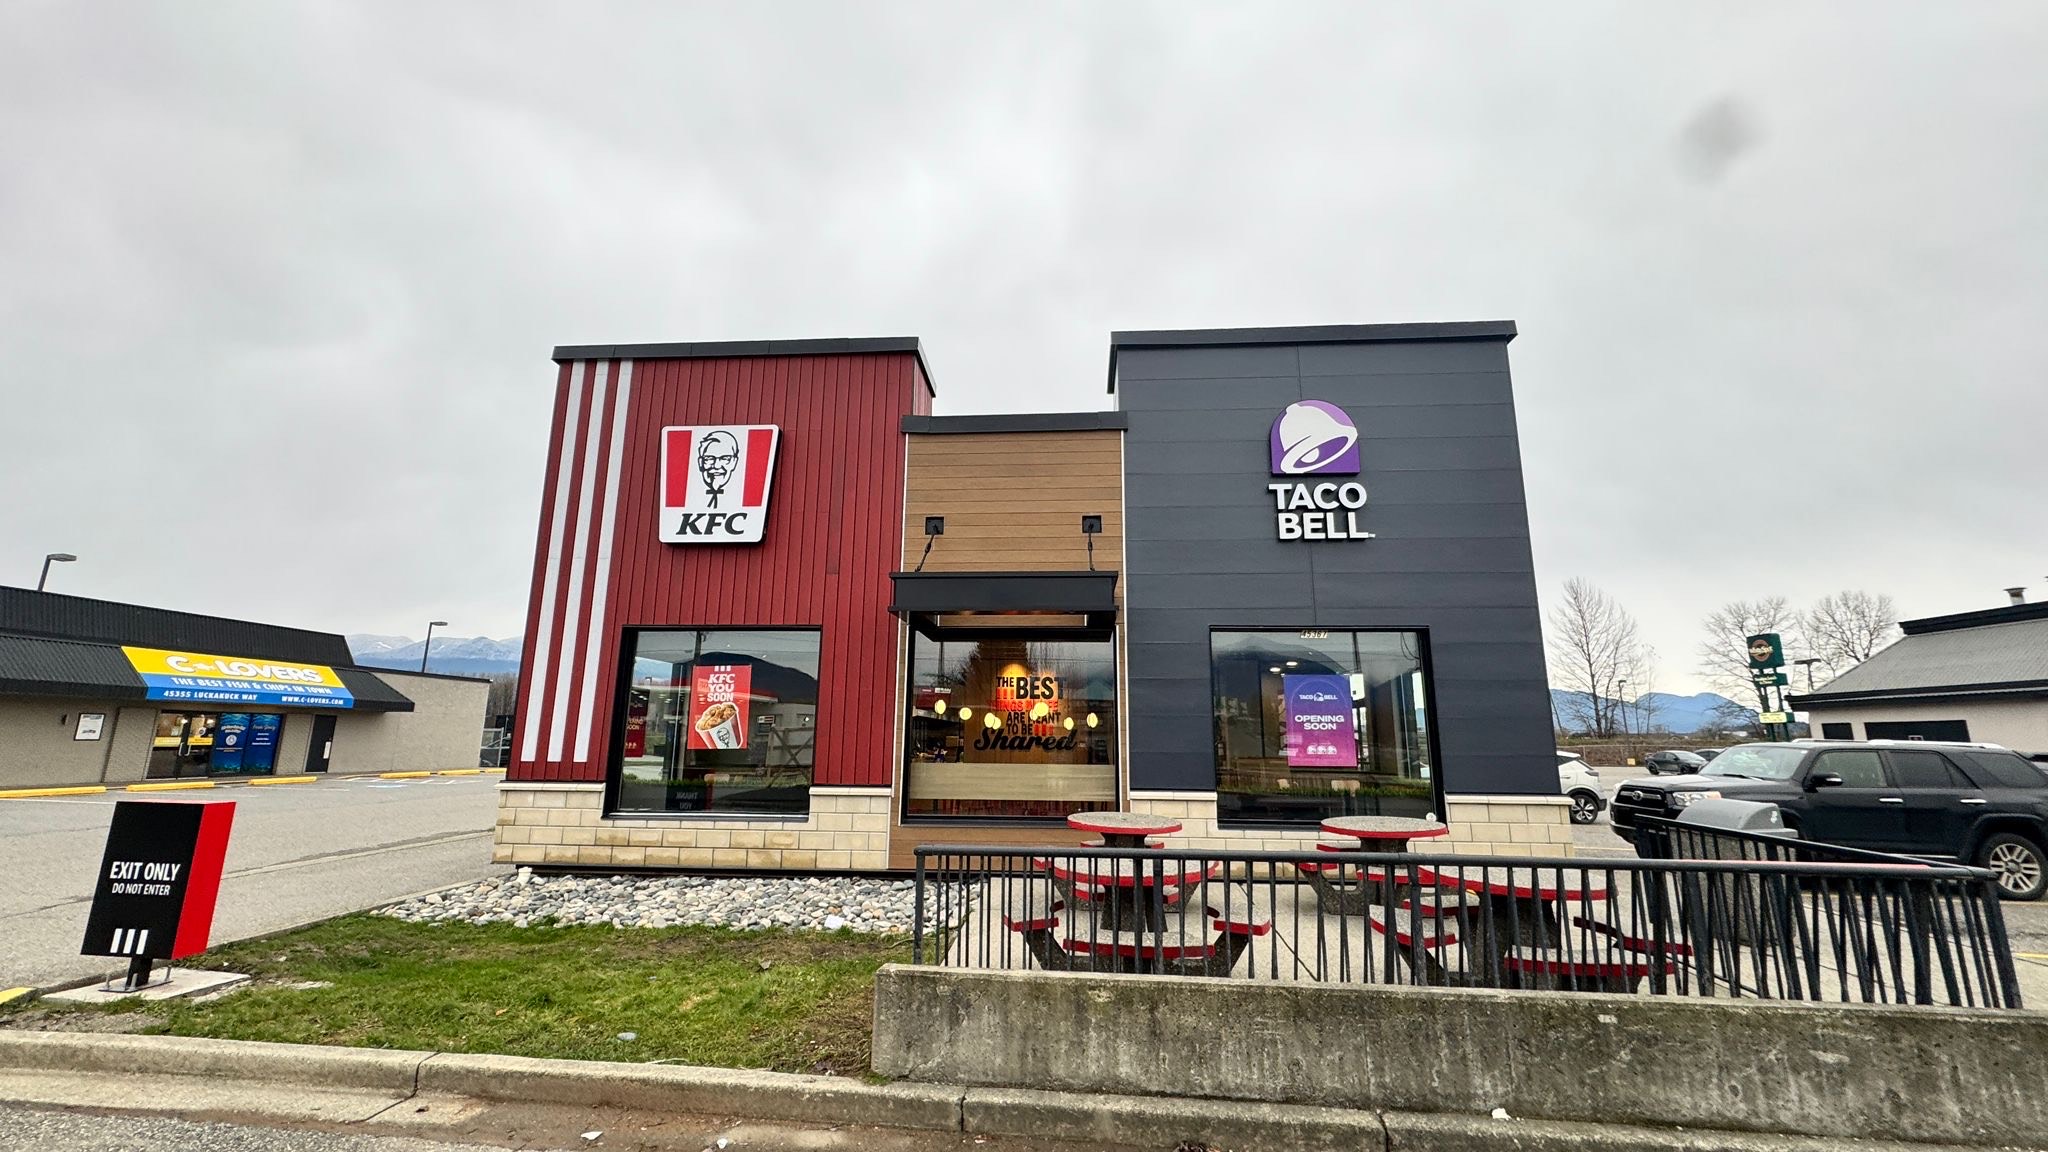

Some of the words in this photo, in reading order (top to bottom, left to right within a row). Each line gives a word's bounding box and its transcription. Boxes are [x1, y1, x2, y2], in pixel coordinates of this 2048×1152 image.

[1268, 482, 1367, 510] TACO
[675, 512, 748, 535] KFC
[1277, 511, 1371, 540] BELL
[708, 673, 735, 684] KFC
[171, 677, 192, 687] THE
[196, 679, 224, 688] BEST
[227, 680, 251, 690] FISH
[253, 682, 261, 690] &
[263, 683, 291, 692] CHIPS
[306, 686, 333, 695] TOWN
[708, 683, 735, 693] YOU
[996, 676, 1015, 688] THE
[1015, 676, 1065, 700] BEST
[163, 690, 191, 698] 45355
[194, 691, 239, 701] LUCKAKUCK
[242, 693, 258, 701] WAY
[281, 695, 344, 705] WWW.C-LOVERS.COM
[707, 692, 734, 702] SOON
[1006, 711, 1026, 724] ARE
[1294, 714, 1345, 723] OPENING
[1006, 723, 1019, 735] TO
[1021, 723, 1033, 735] BE
[1303, 722, 1337, 730] SOON
[973, 726, 1078, 751] Shared
[109, 861, 143, 880] EXIT
[143, 862, 181, 882] ONLY
[111, 882, 125, 894] DO
[124, 883, 143, 895] NOT
[143, 883, 171, 896] ENTER
